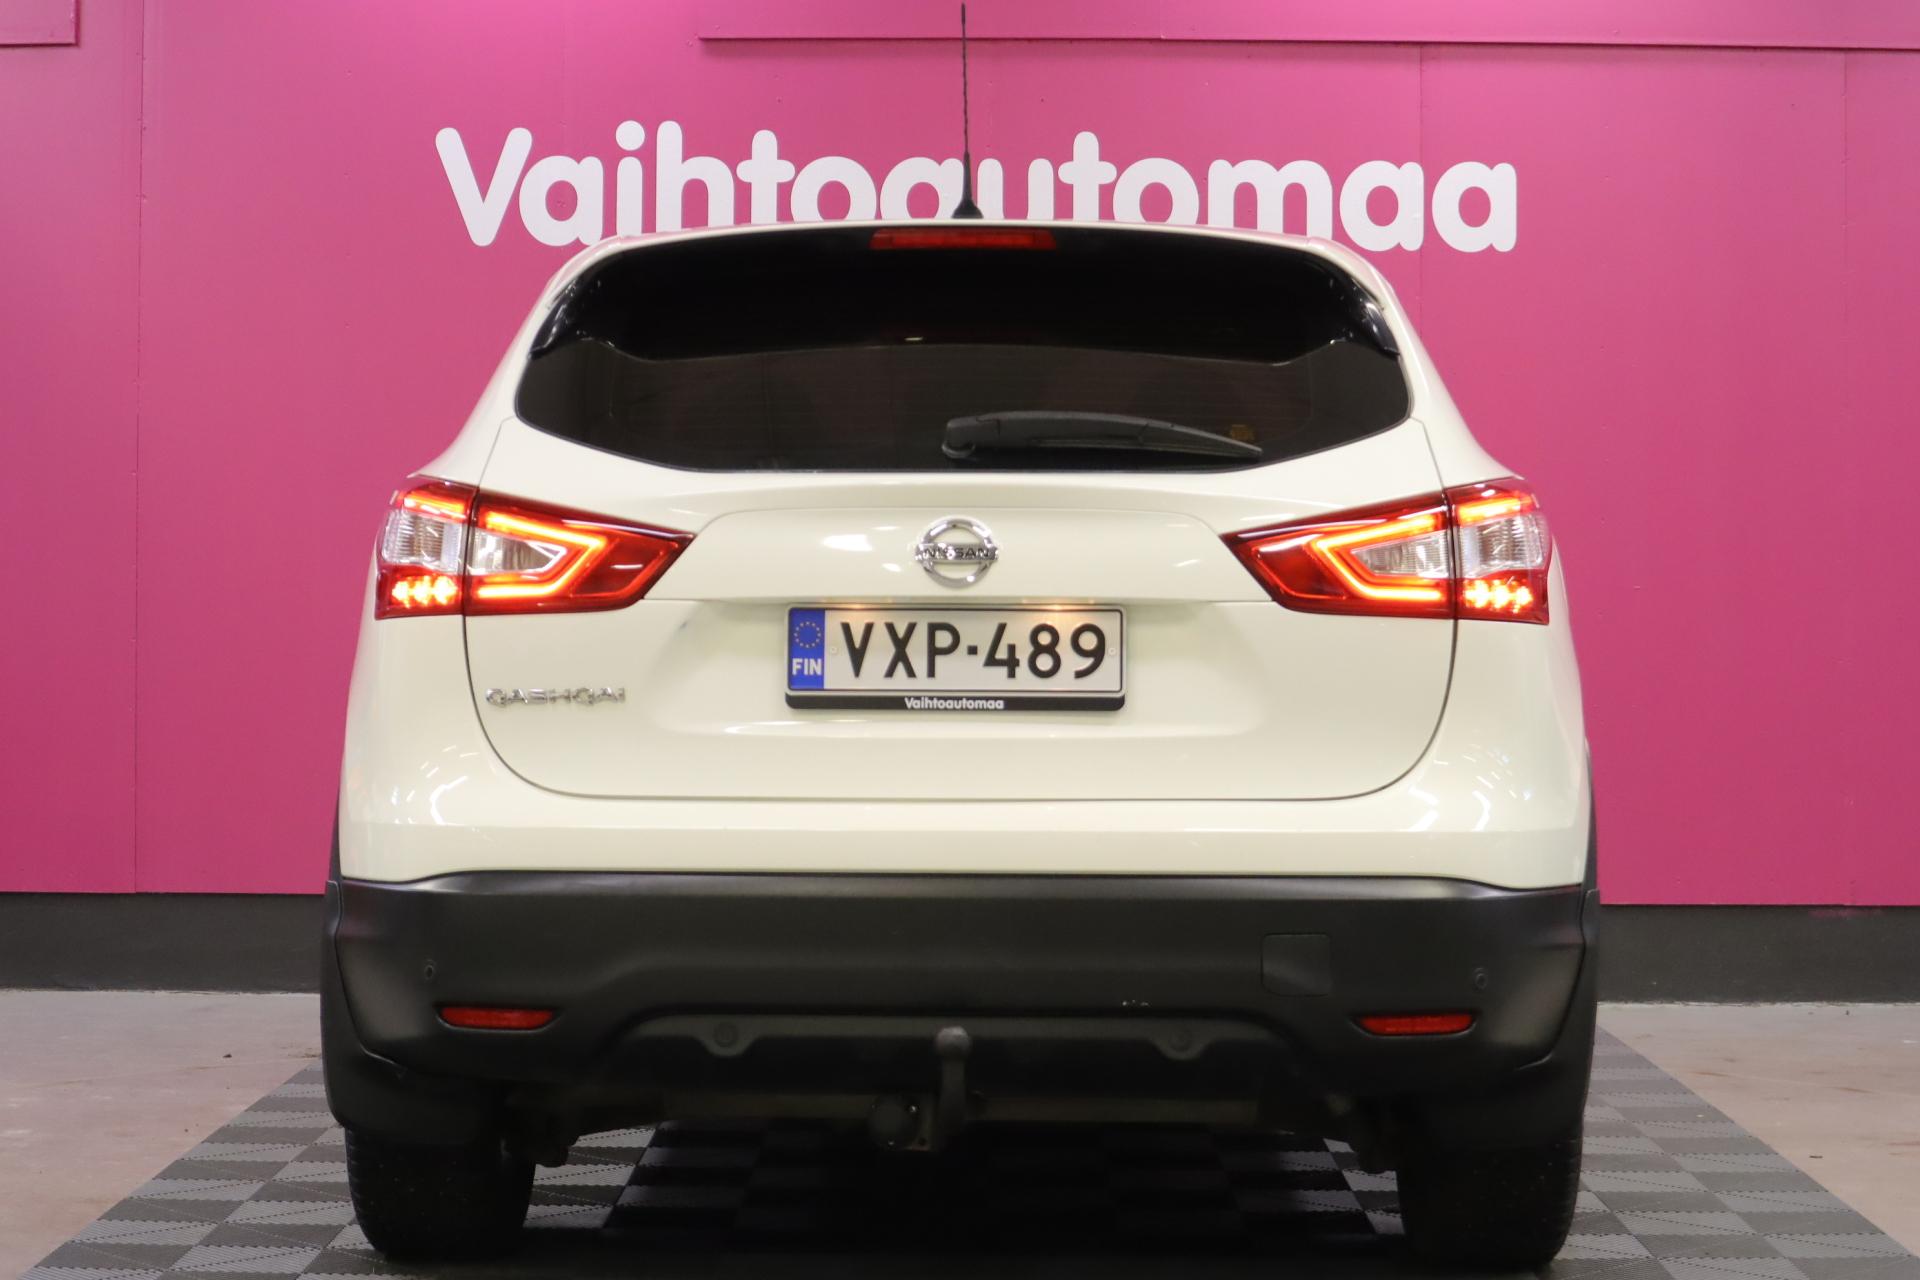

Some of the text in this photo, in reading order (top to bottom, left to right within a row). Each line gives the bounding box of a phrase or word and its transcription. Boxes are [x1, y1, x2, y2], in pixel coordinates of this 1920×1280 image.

[435, 120, 1518, 252] Vaihtoautomaa
[920, 546, 990, 559] NISSAN
[840, 622, 1106, 678] VXP-489
[792, 658, 822, 675] FIN
[485, 687, 626, 706] QASHQAI
[904, 697, 1004, 710] Vaihtoautomaa
